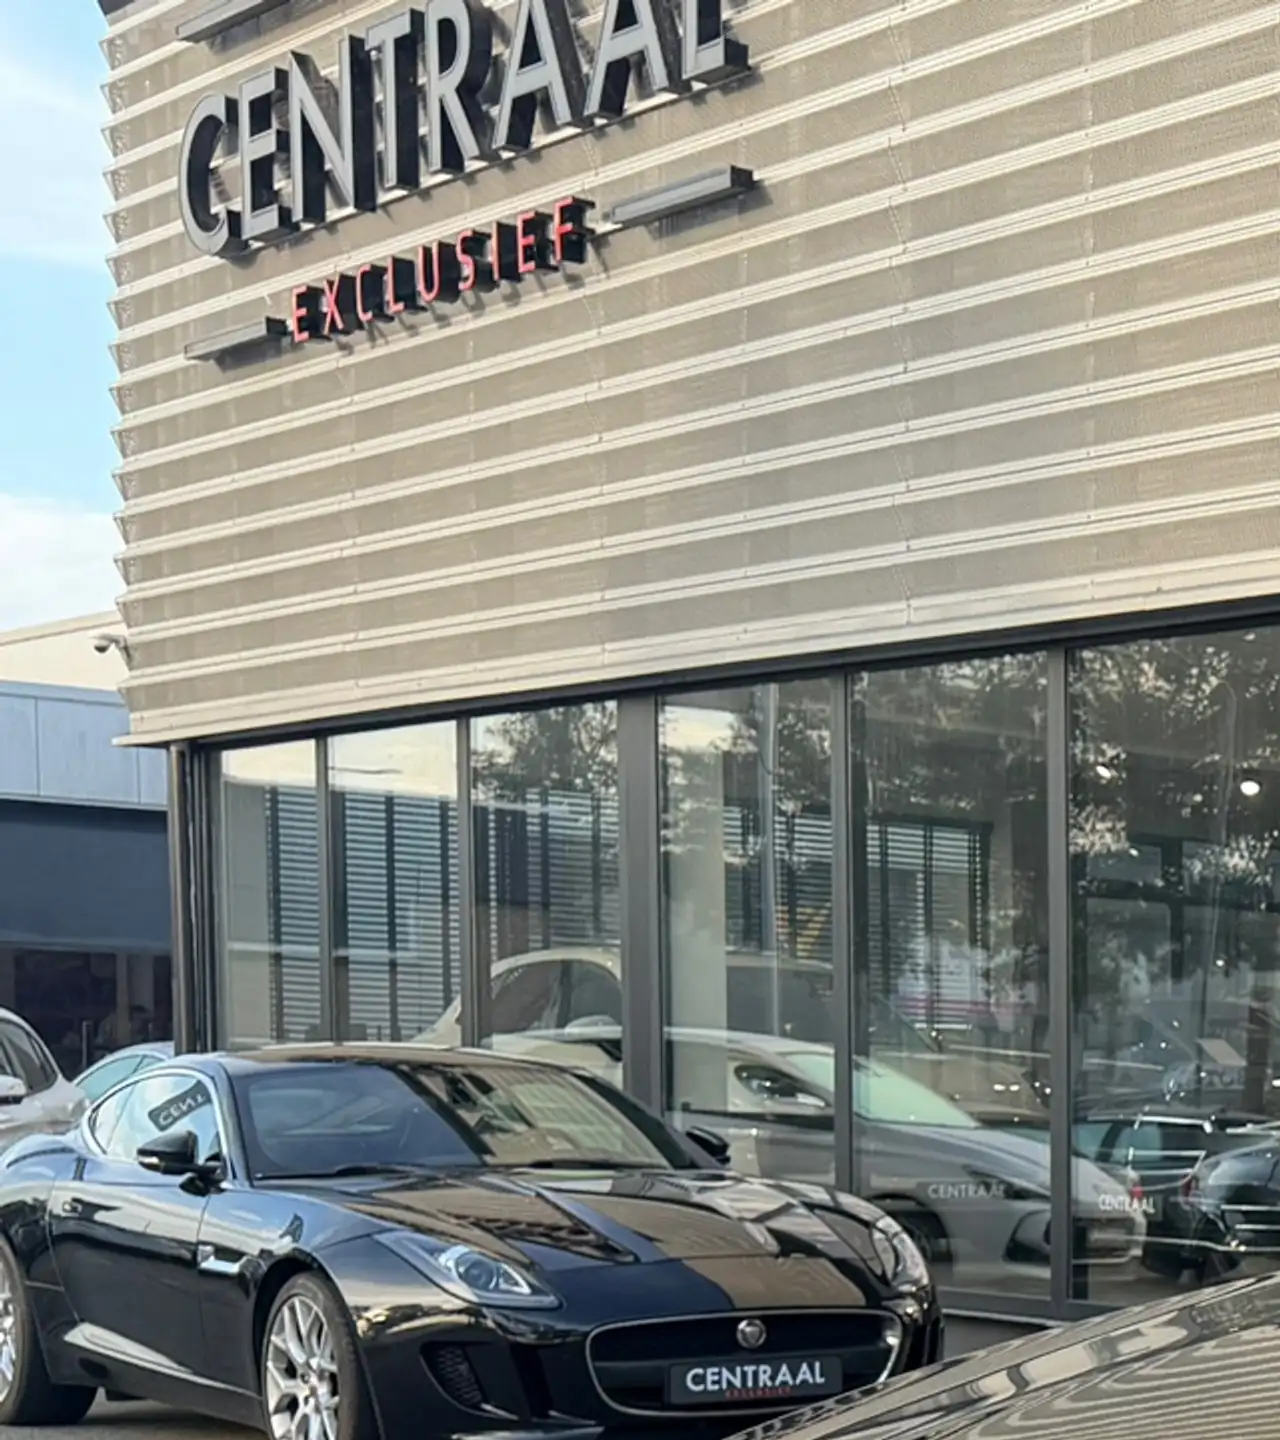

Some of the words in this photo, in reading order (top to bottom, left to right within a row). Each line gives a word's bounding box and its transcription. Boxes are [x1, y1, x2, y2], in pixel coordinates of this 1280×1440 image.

[179, 0, 726, 256] CENTRAAL
[291, 197, 574, 342] EXCLUSIEF
[1098, 1194, 1156, 1214] CENTRAAL
[685, 1360, 826, 1392] CENTRAAL
